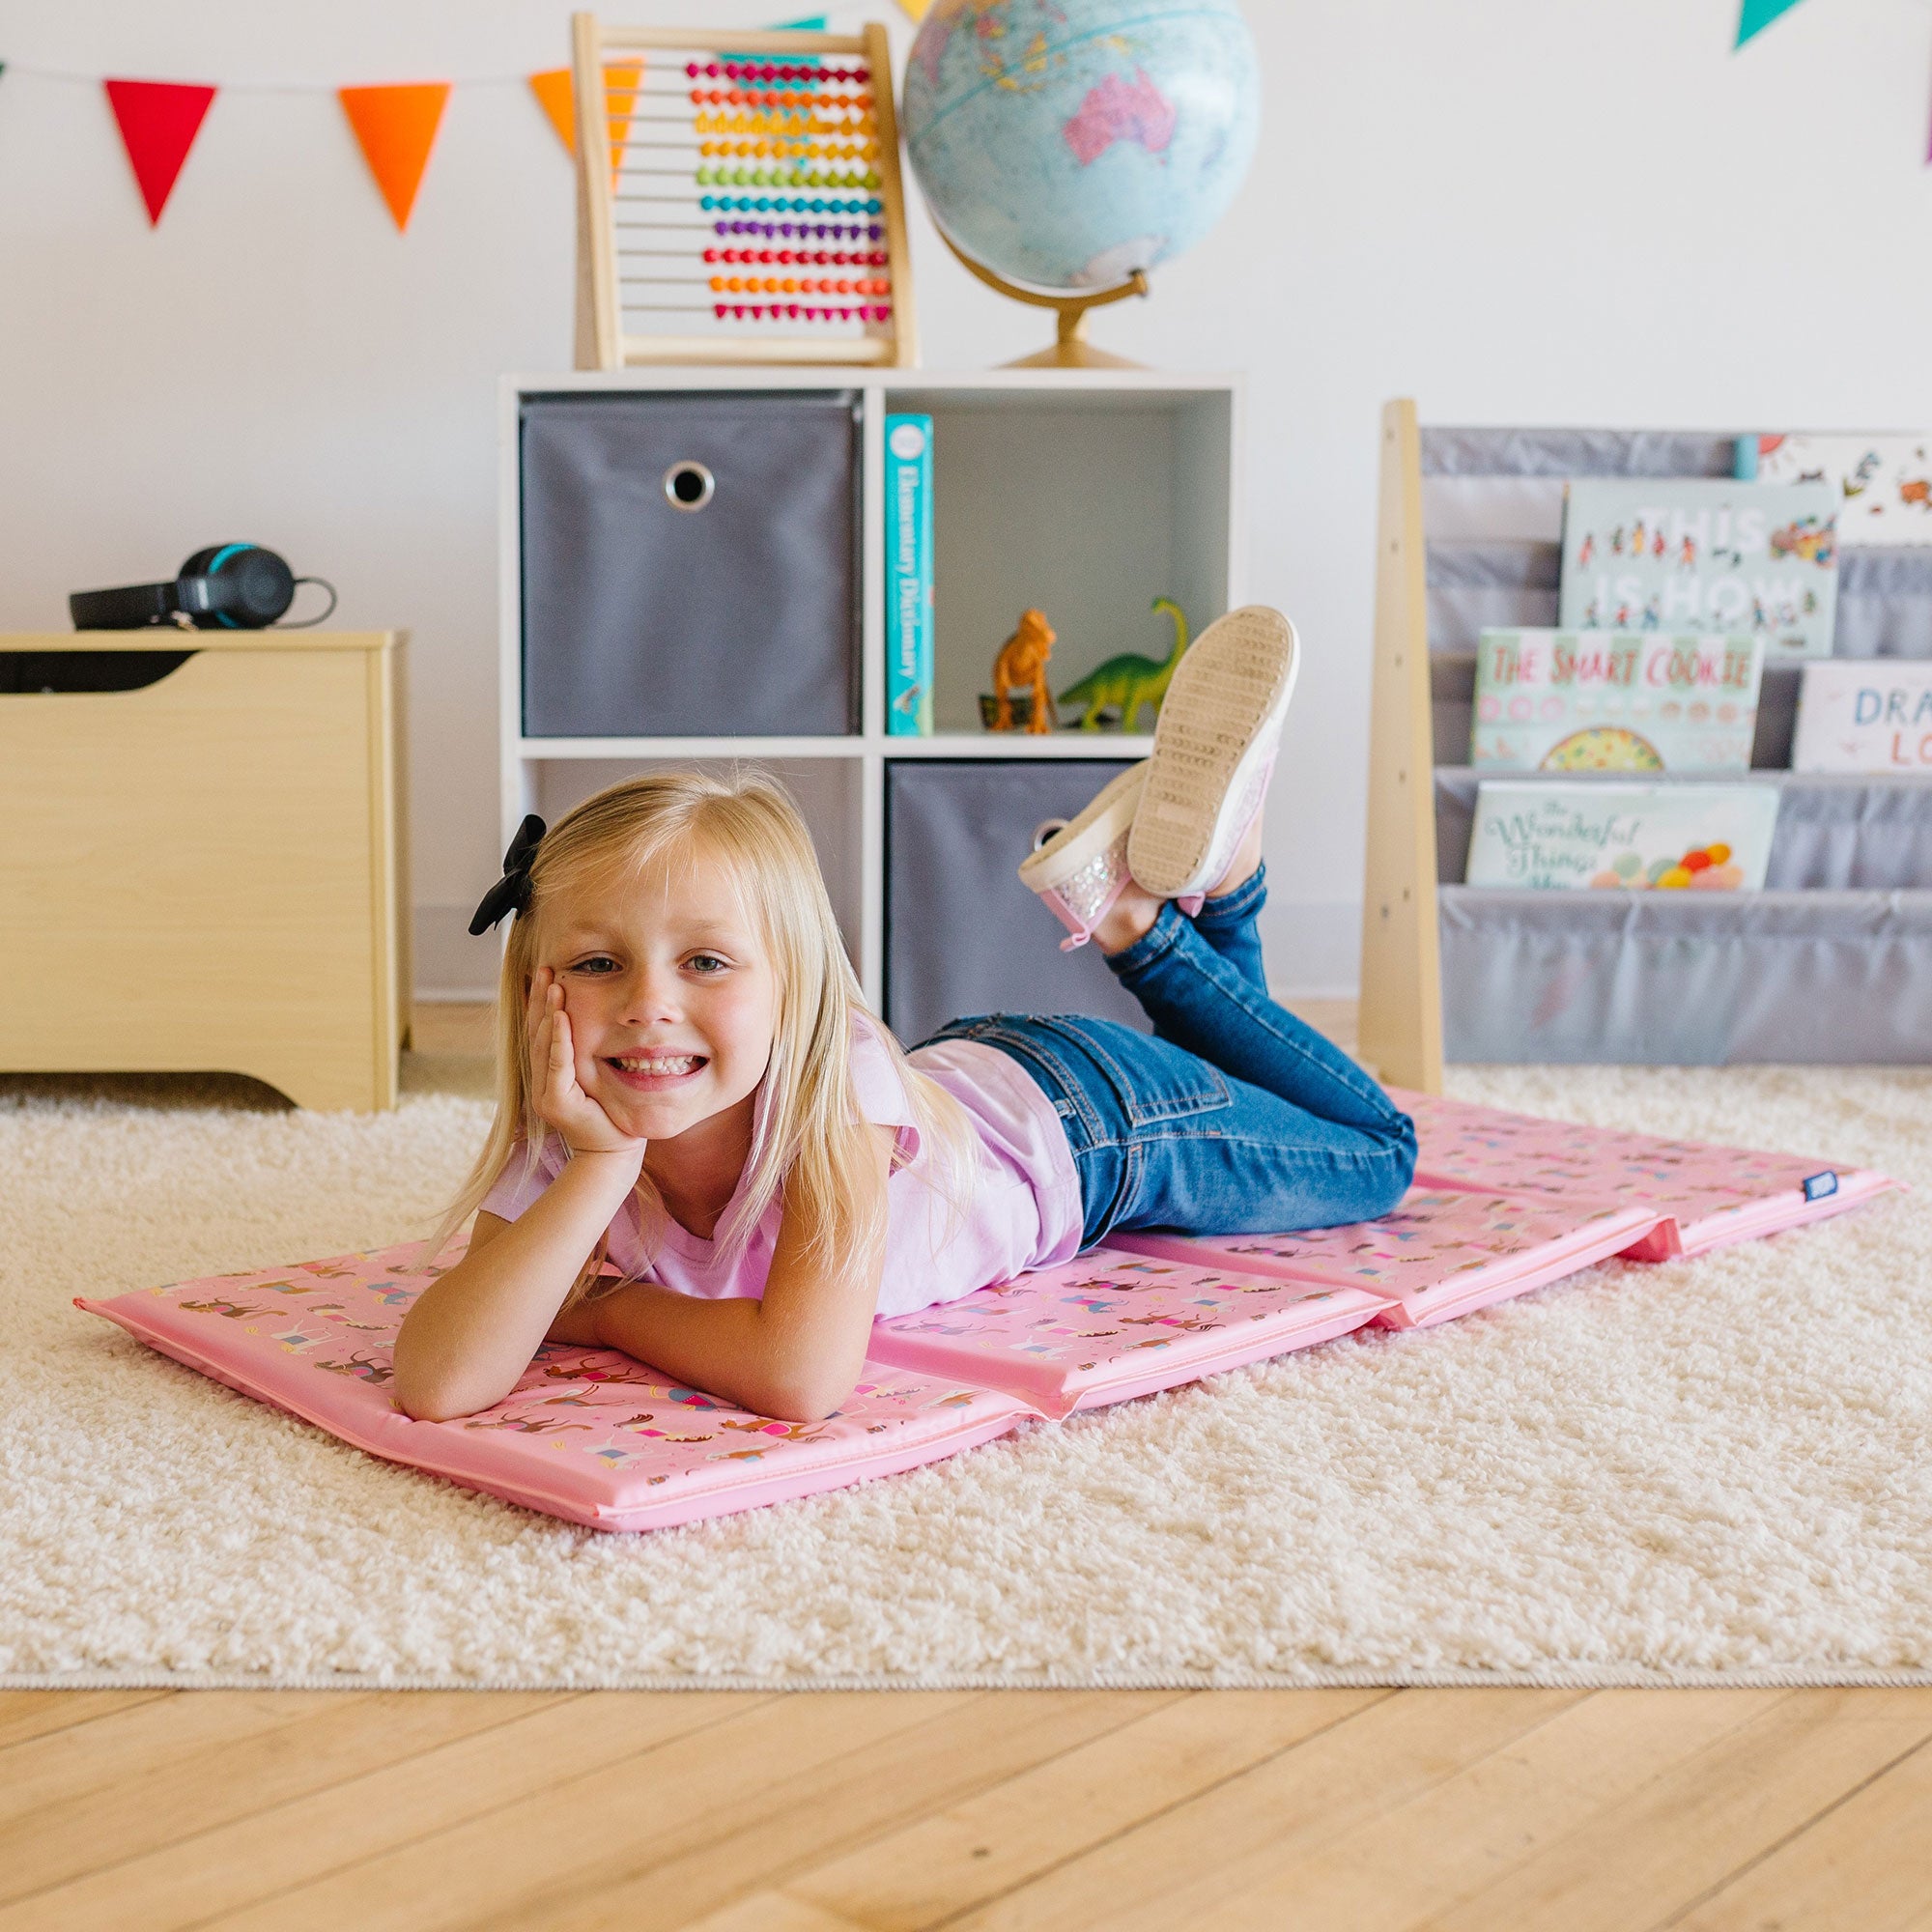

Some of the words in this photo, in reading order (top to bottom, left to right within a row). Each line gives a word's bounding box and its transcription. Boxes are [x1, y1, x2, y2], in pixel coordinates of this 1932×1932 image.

[895, 466, 919, 577] Elementary
[1635, 507, 1765, 552] THIS
[1600, 577, 1643, 613] IS
[1663, 577, 1804, 621] HOW
[898, 578, 921, 679] Dictionary
[1494, 646, 1537, 683] THE
[1549, 646, 1635, 686] SMART
[1646, 647, 1748, 688] COOKIE
[1485, 810, 1642, 848] Wonderful
